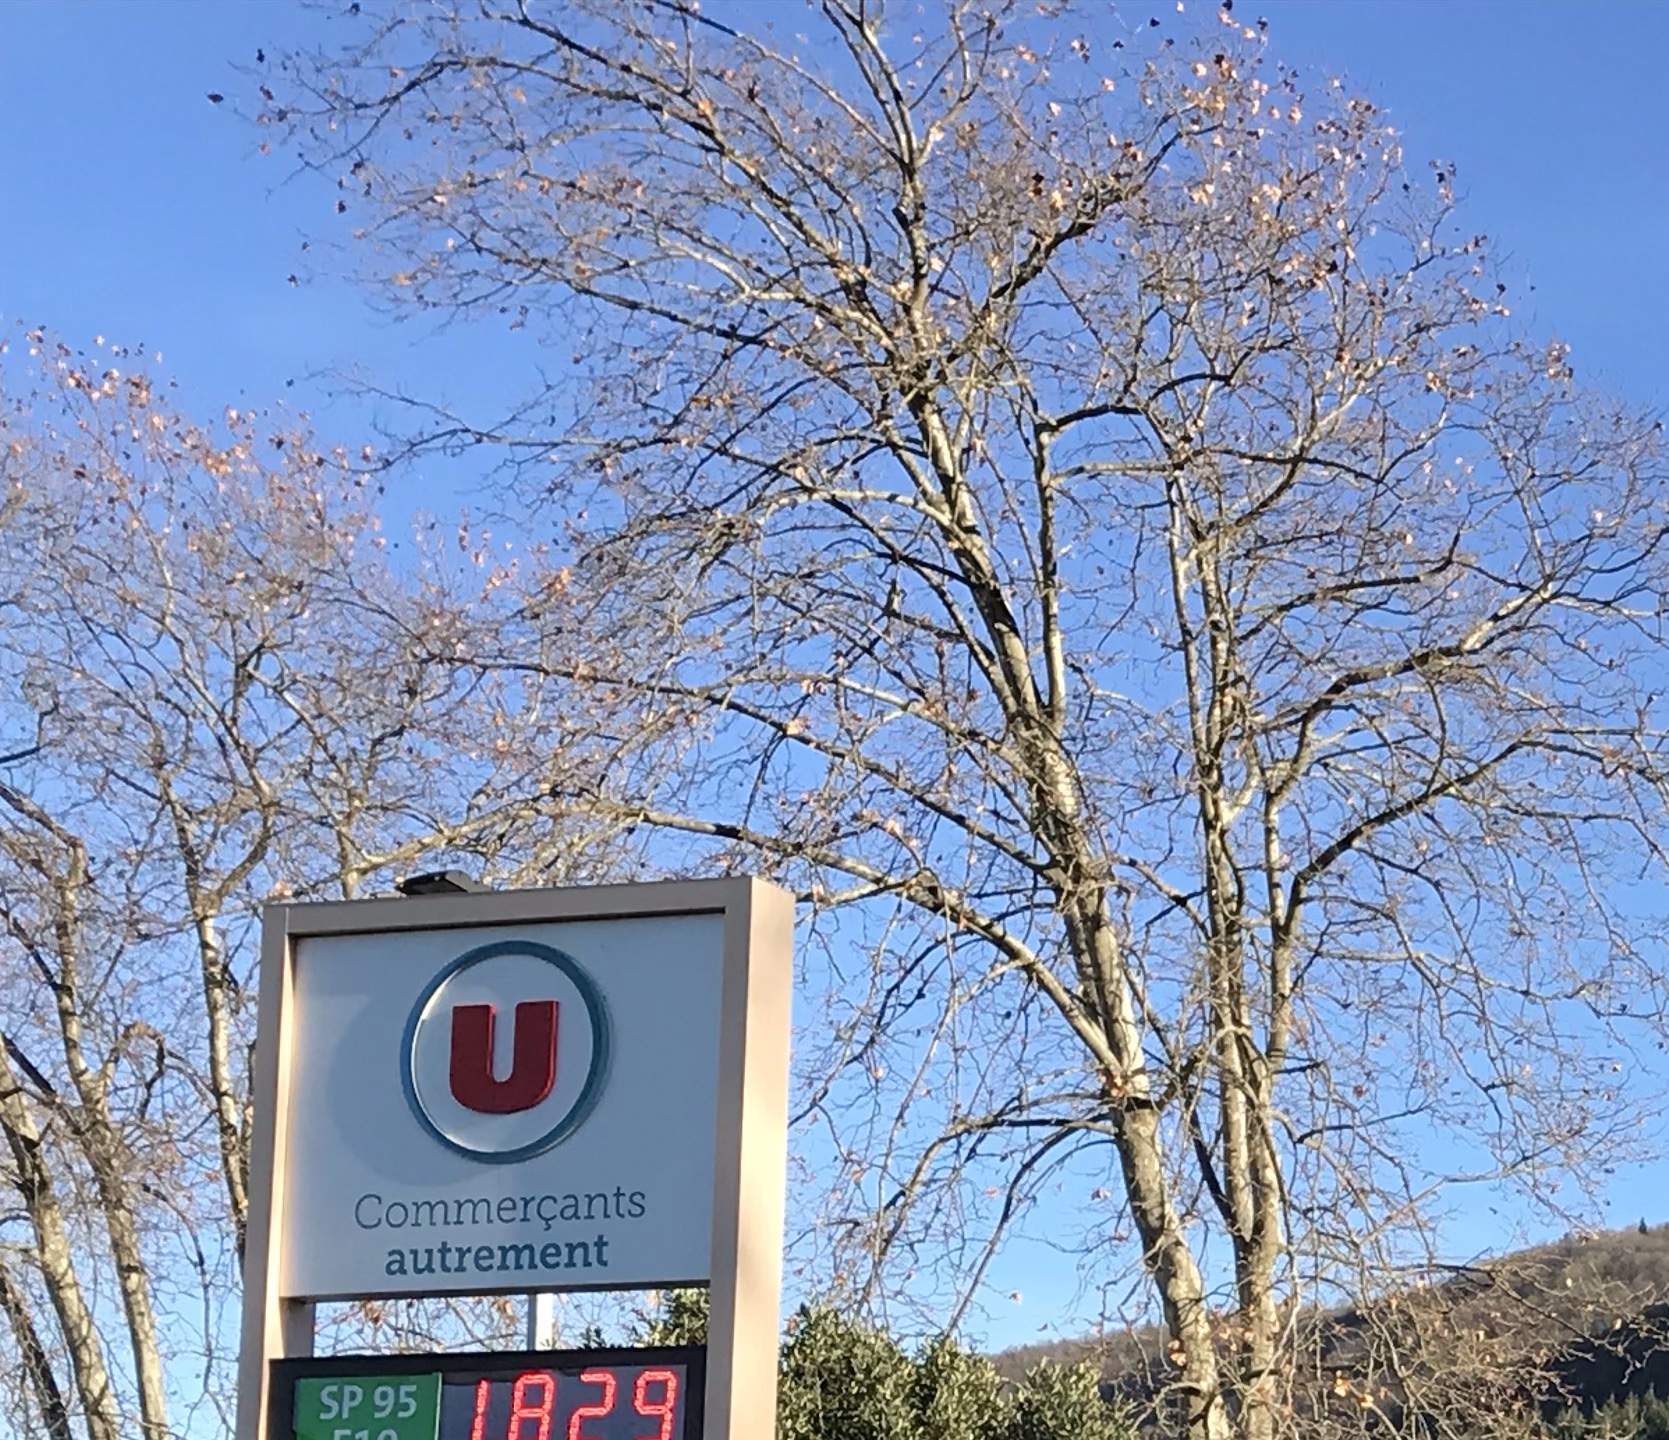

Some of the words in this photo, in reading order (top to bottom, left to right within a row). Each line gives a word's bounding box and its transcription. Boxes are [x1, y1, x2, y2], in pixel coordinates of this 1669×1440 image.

[449, 999, 560, 1115] U
[354, 1185, 647, 1231] Commerçants
[384, 1234, 610, 1277] autrement
[319, 1384, 364, 1420] SP
[373, 1384, 418, 1419] 95
